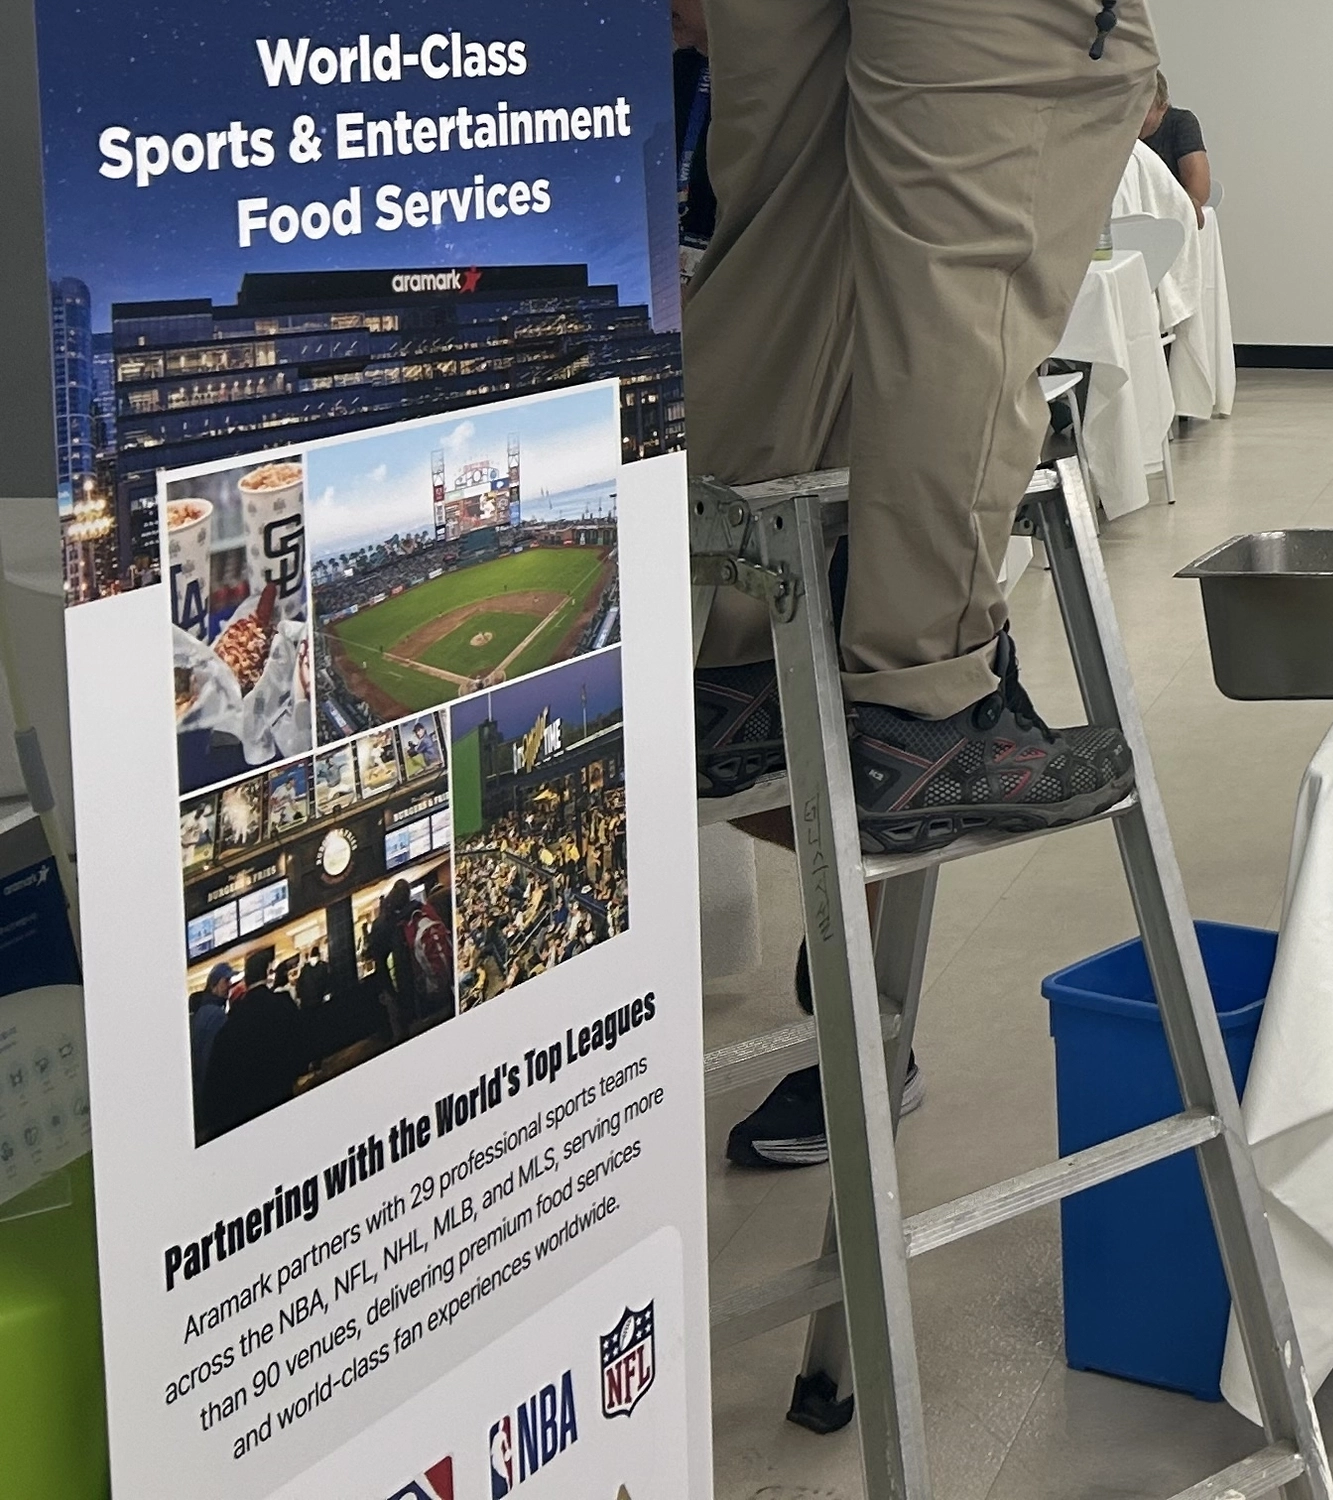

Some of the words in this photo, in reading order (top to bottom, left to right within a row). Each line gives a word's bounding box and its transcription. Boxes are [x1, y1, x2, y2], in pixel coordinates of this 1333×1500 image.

[255, 32, 528, 87] World-Class
[98, 121, 275, 187] Sports
[289, 114, 323, 164] &
[336, 97, 631, 160] Entertainment
[237, 186, 362, 248] Food
[375, 174, 551, 231] Services
[391, 268, 461, 293] aramark
[164, 1174, 320, 1292] Partnering
[323, 1135, 385, 1200] with
[389, 1113, 431, 1164] the
[435, 1062, 520, 1139] World's
[524, 1041, 562, 1088] Top
[567, 991, 656, 1065] Leagues
[165, 1346, 235, 1405] across
[239, 1323, 274, 1358] the
[279, 1288, 329, 1335] NBA,
[334, 1259, 378, 1301] NFL,
[384, 1230, 428, 1271] NHL,
[434, 1196, 478, 1240] MLB,
[482, 1171, 514, 1210] and
[518, 1146, 559, 1189] MLS,
[563, 1111, 620, 1160] serving
[624, 1086, 665, 1124] more
[184, 1272, 273, 1345] Aramark
[278, 1223, 361, 1294] partners
[366, 1195, 405, 1235] with
[410, 1176, 435, 1209] 29
[440, 1111, 542, 1199] professional
[546, 1085, 596, 1131] sports
[600, 1056, 648, 1098] teams
[200, 1387, 248, 1432] than
[253, 1361, 281, 1398] 90
[285, 1318, 361, 1377] venues,
[367, 1258, 455, 1326] delivering
[459, 1207, 533, 1275] premium
[536, 1176, 574, 1214] food
[577, 1138, 643, 1193] services
[233, 1413, 272, 1460] and
[277, 1343, 390, 1430] world-class
[393, 1320, 423, 1354] fan
[427, 1249, 532, 1332] experiences
[535, 1195, 621, 1262] worldwide.
[517, 1368, 579, 1485] NBA
[606, 1344, 652, 1409] NFL
